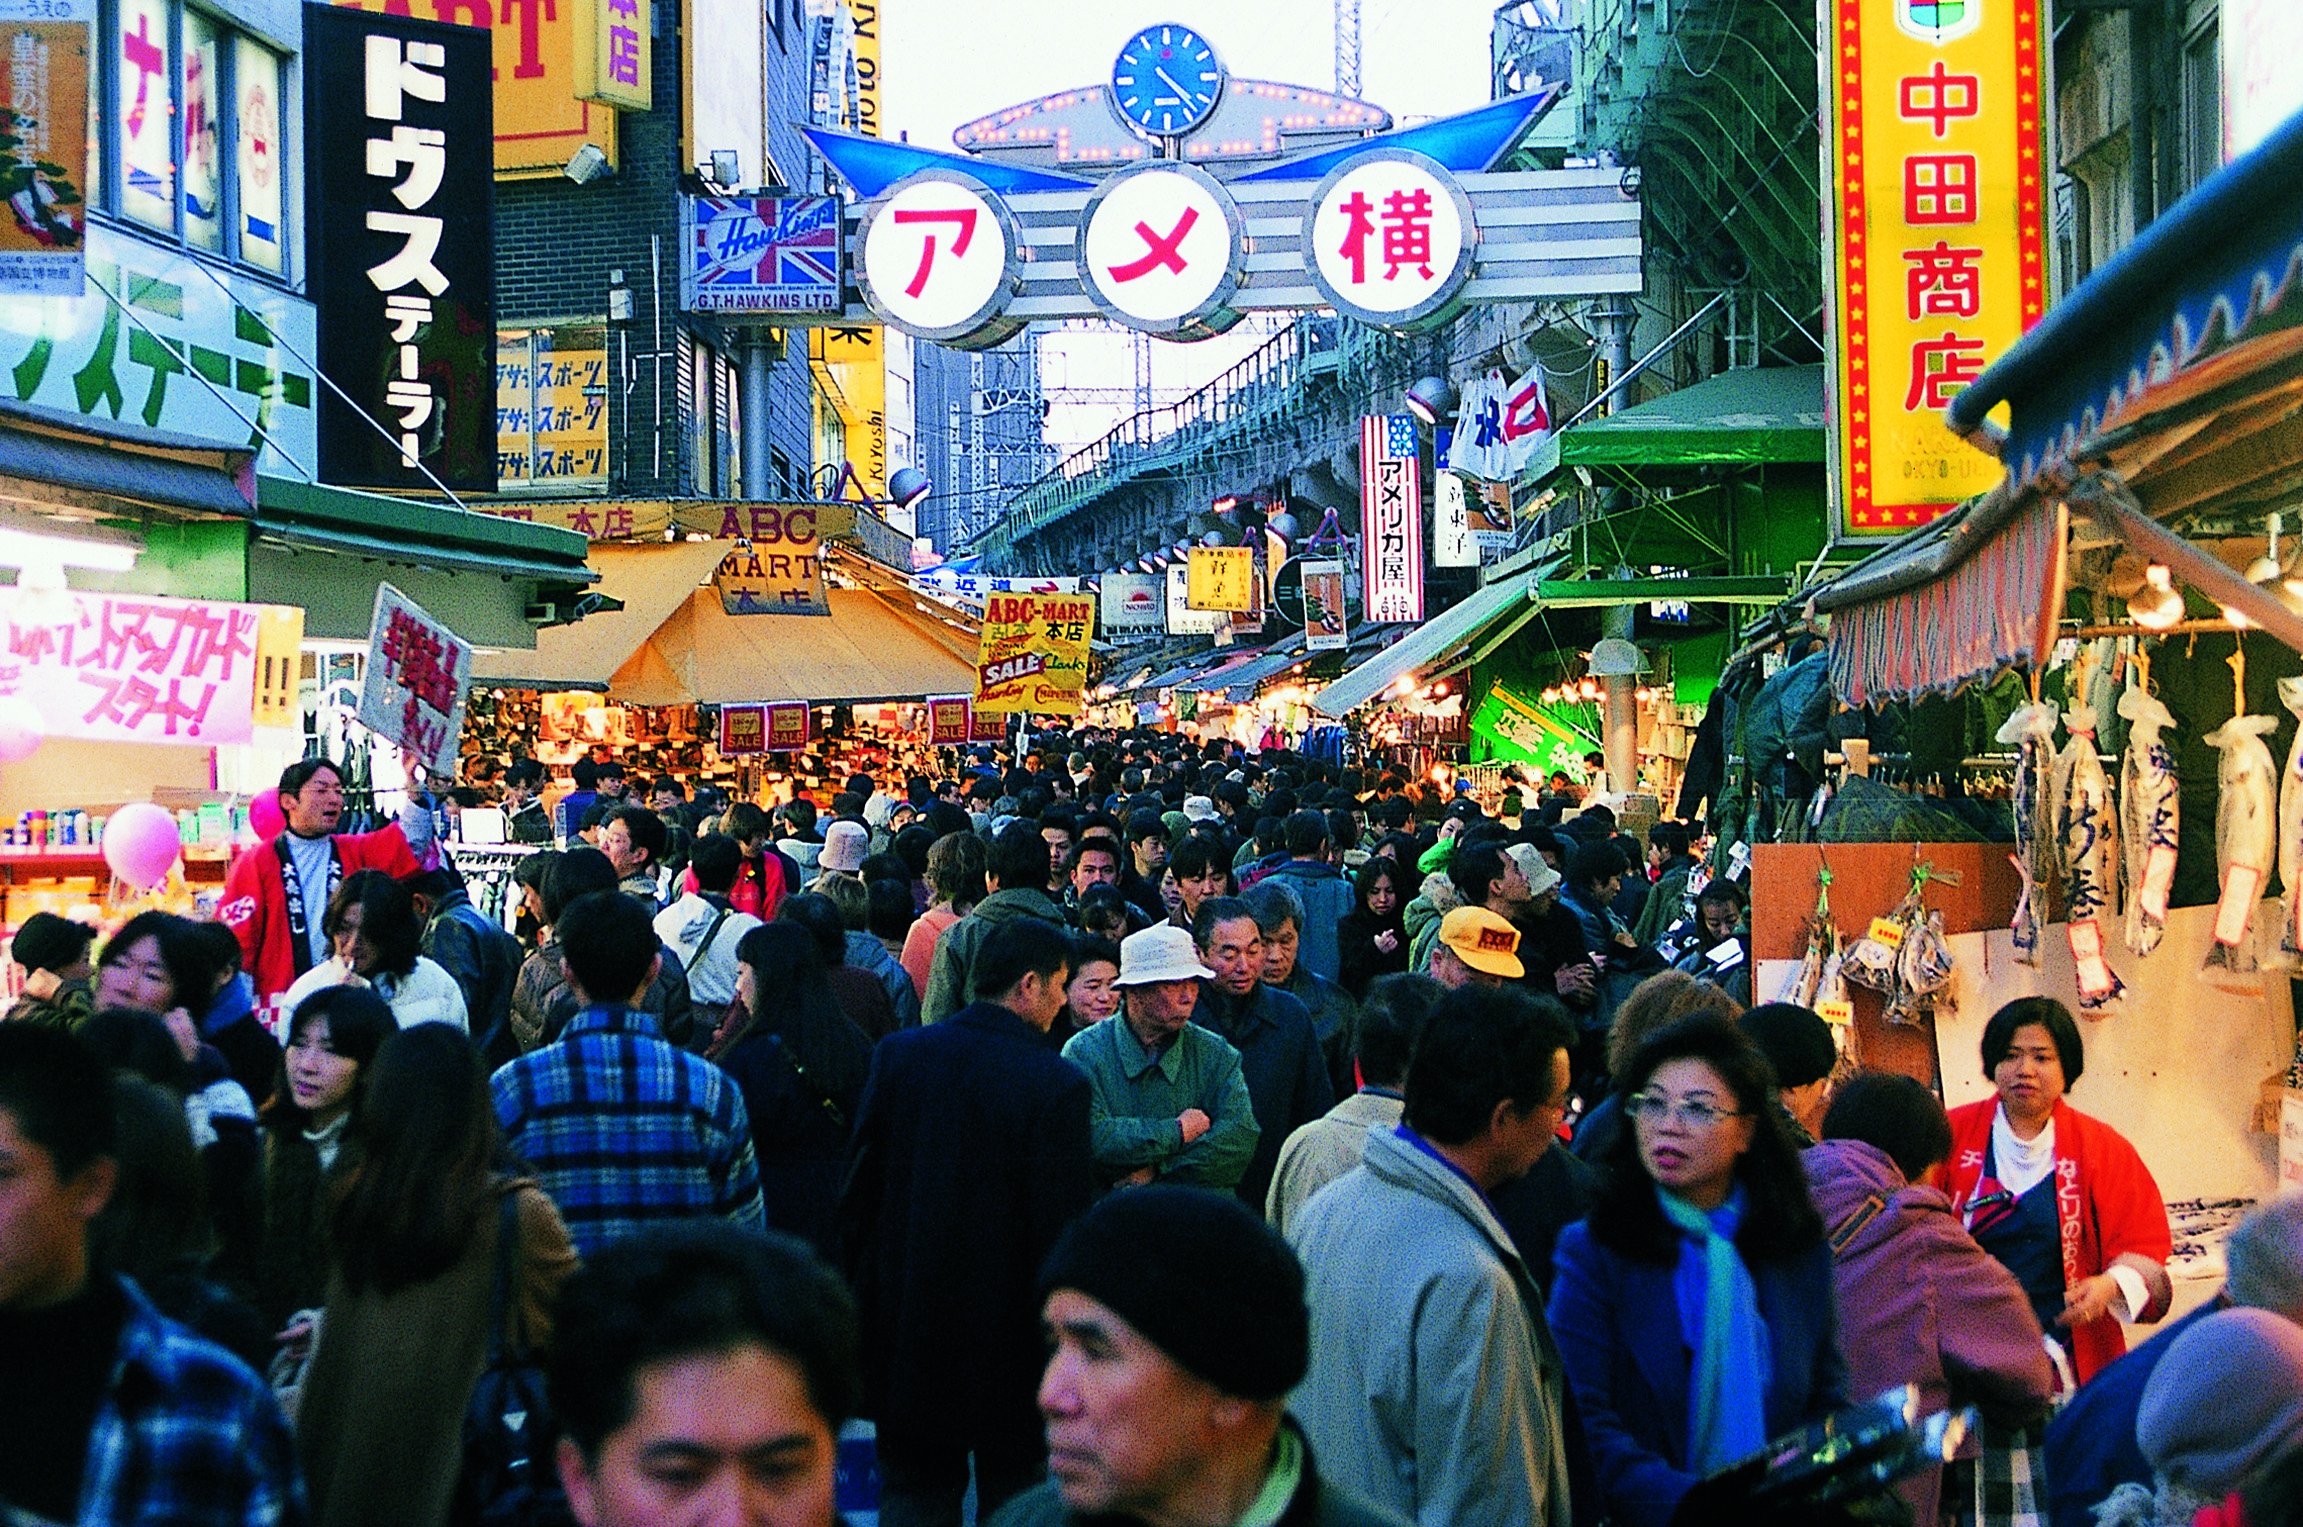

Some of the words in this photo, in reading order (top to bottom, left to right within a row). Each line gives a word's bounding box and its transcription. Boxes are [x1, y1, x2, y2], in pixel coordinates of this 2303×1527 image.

[894, 187, 1433, 299] アメ横
[1900, 61, 1985, 411] 中田商店
[365, 34, 450, 468] ドヴステーラー
[805, 294, 838, 308] LTD.
[715, 506, 817, 545] ABC
[1378, 461, 1405, 580] アメリカ屋
[718, 553, 818, 579] MART
[986, 597, 1090, 624] ABC-MART
[1046, 620, 1085, 642] 本店
[985, 653, 1041, 684] SALE
[728, 735, 761, 747] SALE
[772, 731, 804, 744] SALE
[935, 726, 966, 738] SALE
